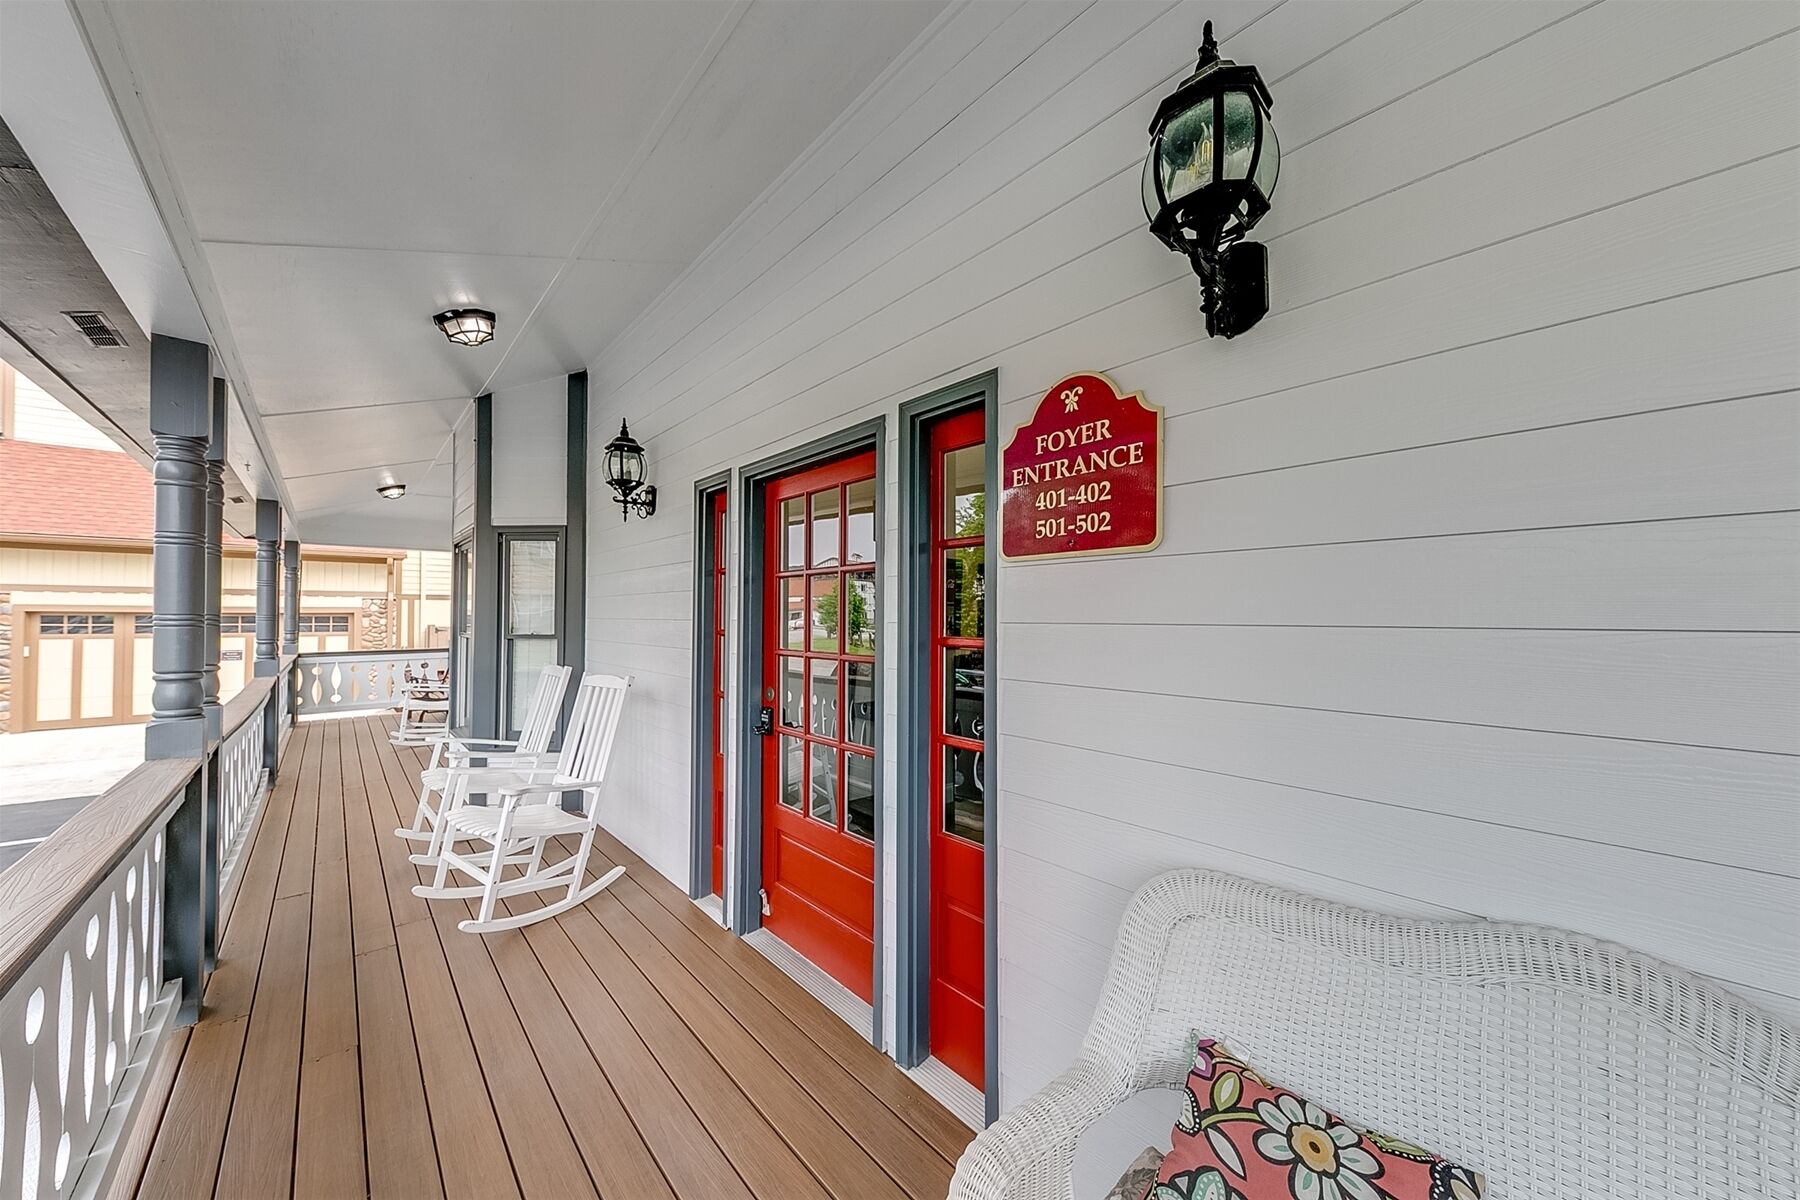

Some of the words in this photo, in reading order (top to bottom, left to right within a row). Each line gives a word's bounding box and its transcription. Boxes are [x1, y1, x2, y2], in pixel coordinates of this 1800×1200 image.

[1035, 419, 1112, 455] FOYER
[1012, 442, 1144, 487] ENTRANCE
[1035, 481, 1111, 510] 401-402
[1035, 511, 1111, 538] 501-502
